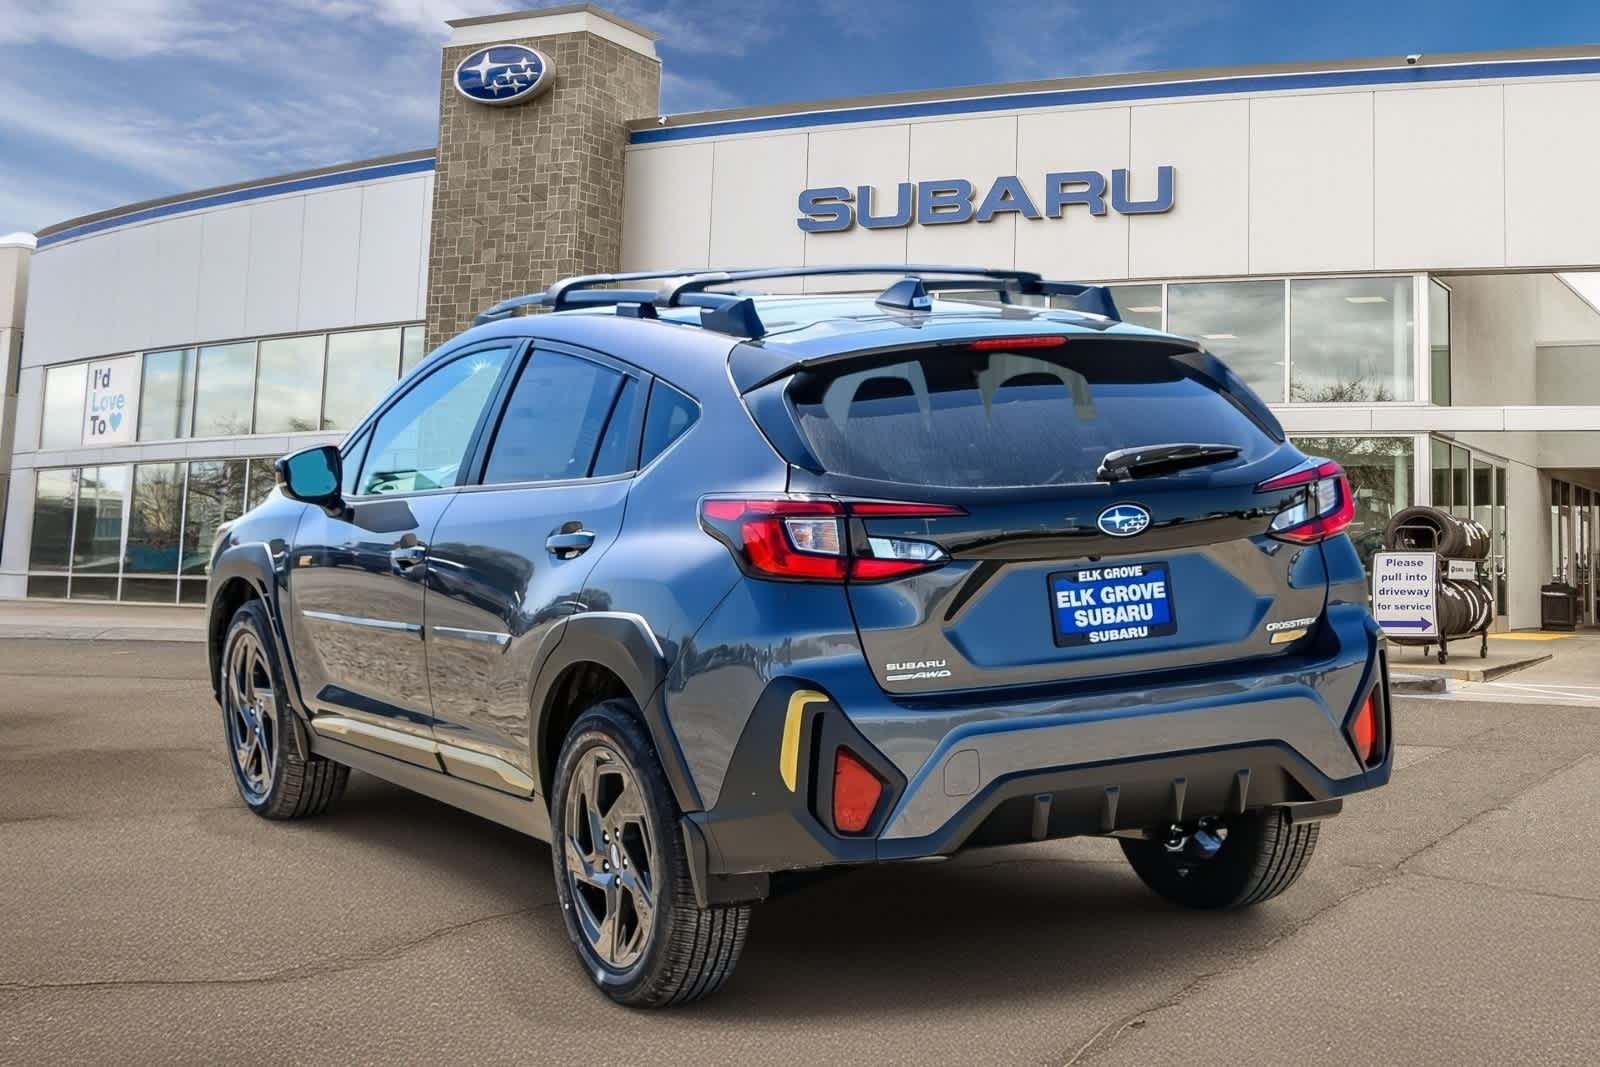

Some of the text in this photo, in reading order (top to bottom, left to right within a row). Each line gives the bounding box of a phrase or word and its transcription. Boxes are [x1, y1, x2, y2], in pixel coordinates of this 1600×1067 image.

[797, 166, 1175, 232] SUBARU
[93, 367, 111, 389] I'd
[92, 392, 125, 412] Love
[91, 416, 106, 435] To
[1386, 559, 1424, 567] Please
[1078, 566, 1143, 582] ELK GROVE
[1381, 573, 1428, 582] pull into
[1056, 581, 1166, 608] ELK GROVE
[1378, 588, 1430, 598] driveway
[1074, 603, 1153, 627] SUBARU
[1377, 603, 1432, 611] for service
[1089, 626, 1148, 643] SUBARU
[886, 659, 946, 671] SUBARU
